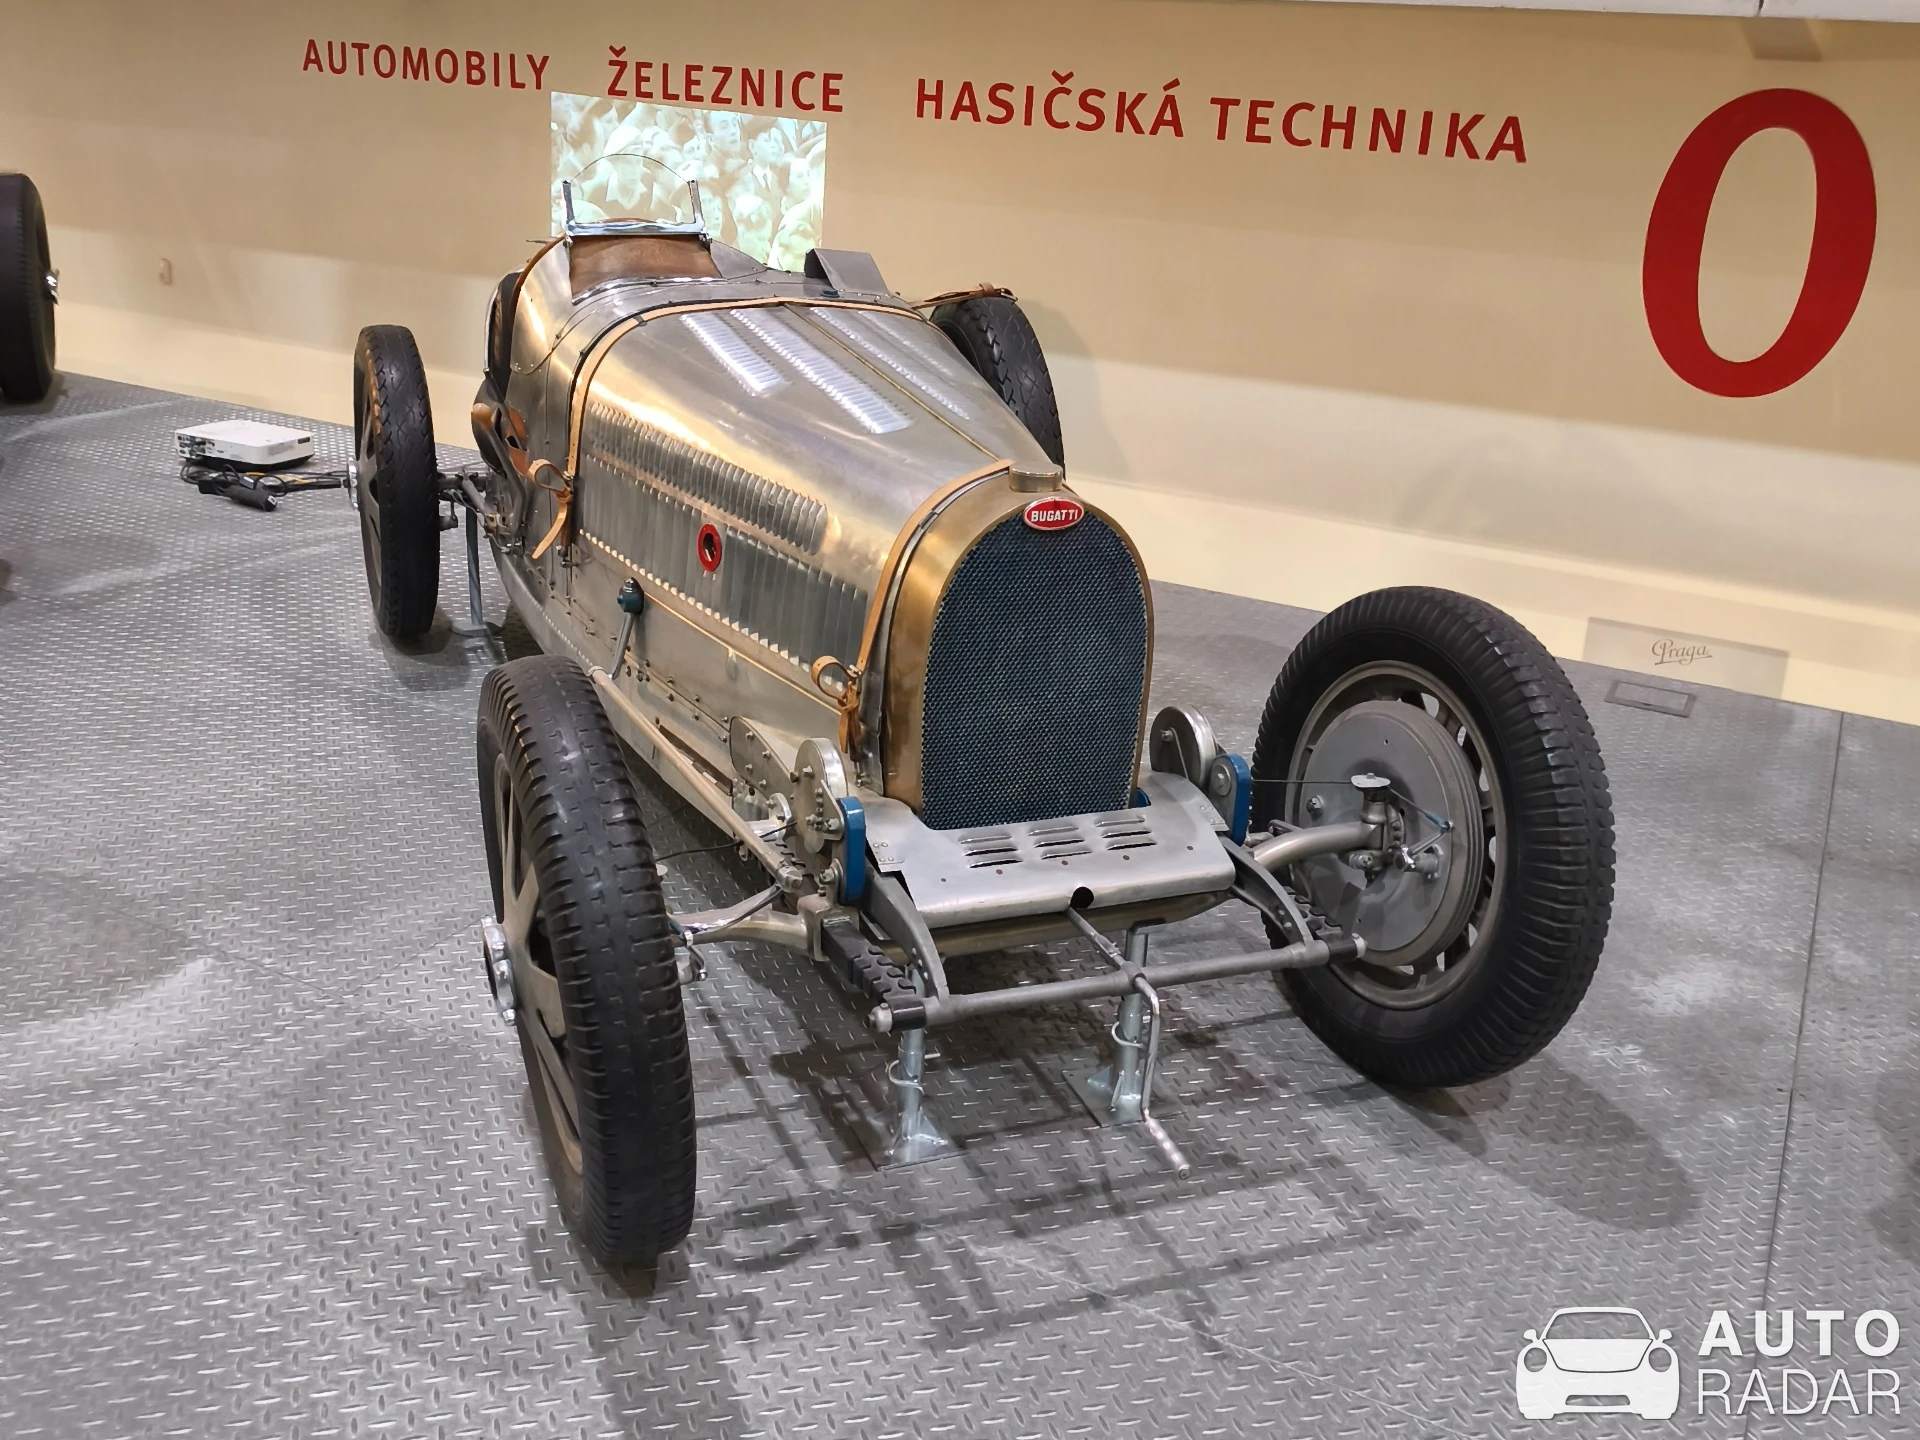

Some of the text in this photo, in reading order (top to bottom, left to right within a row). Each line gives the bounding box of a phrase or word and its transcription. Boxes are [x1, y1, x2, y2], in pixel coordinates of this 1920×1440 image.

[302, 39, 550, 91] AUTOMOBILY
[607, 46, 844, 113] ŽELEZNICE
[915, 70, 1527, 163] HASIČSKÁ TECHNIKA
[1031, 509, 1079, 522] BUGATTI
[1651, 638, 1713, 666] Praga
